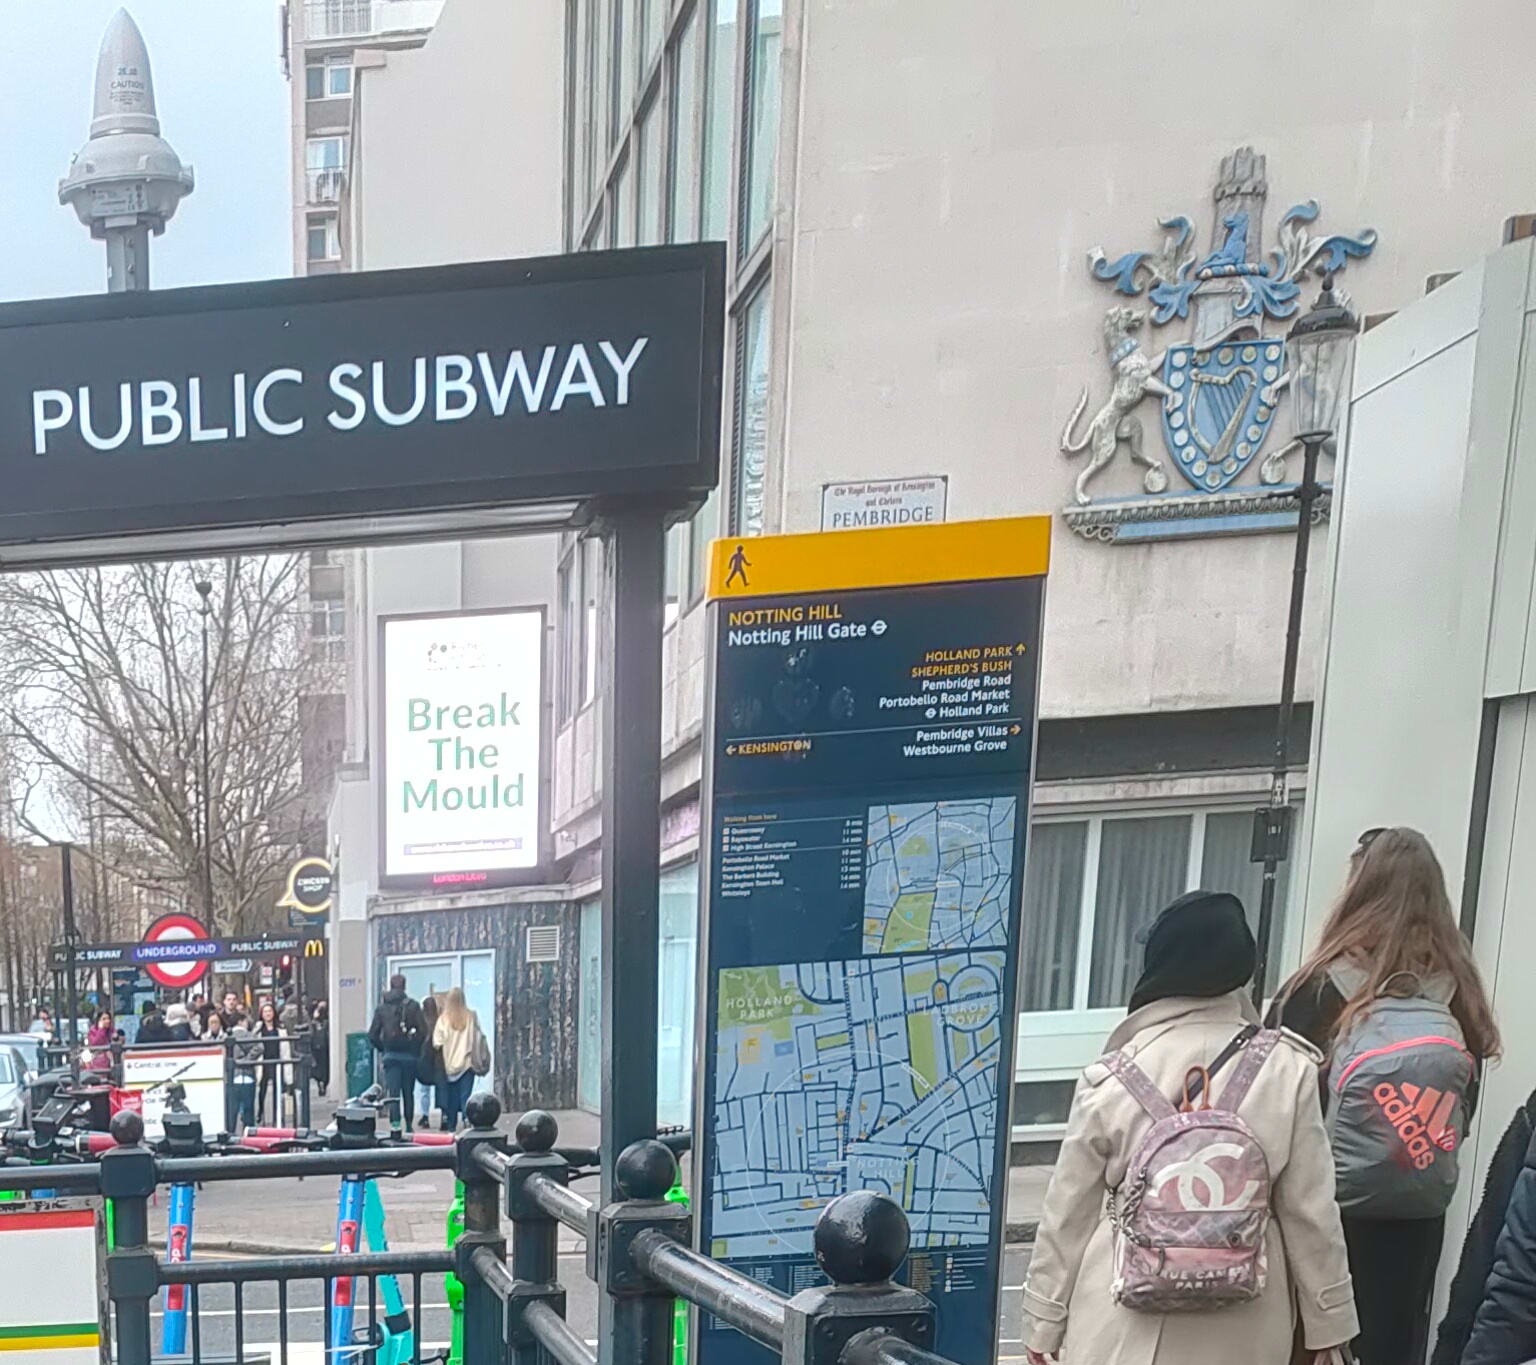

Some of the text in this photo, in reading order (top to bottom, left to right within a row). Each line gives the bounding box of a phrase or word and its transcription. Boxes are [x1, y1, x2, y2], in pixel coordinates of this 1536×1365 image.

[31, 337, 650, 456] PUBLIC SUBWAY
[832, 505, 934, 529] PEMBRIDGE
[728, 604, 843, 627] NOTTING HILL
[728, 621, 867, 647] Notting Hill Gate
[925, 646, 1013, 663] HOLLAND PARK
[911, 660, 1012, 678] SHEPHERD'S BUSH
[922, 674, 1012, 691] Pembridge Road
[879, 688, 1010, 709] Portobello Road Market
[408, 692, 521, 731] Break
[939, 703, 1009, 718] Holland Park
[916, 725, 1008, 742] Pembridge Villas
[428, 736, 499, 770] The
[738, 740, 812, 755] KENSINGTON
[903, 740, 1008, 757] Westbourne Grove
[403, 773, 524, 813] Mould
[136, 944, 217, 959] UNDERGROUND
[231, 940, 299, 952] PUBLIC SUBWAY
[725, 995, 793, 1009] HOLLAND
[739, 1009, 775, 1021] PARK
[1373, 1081, 1434, 1170] adidas
